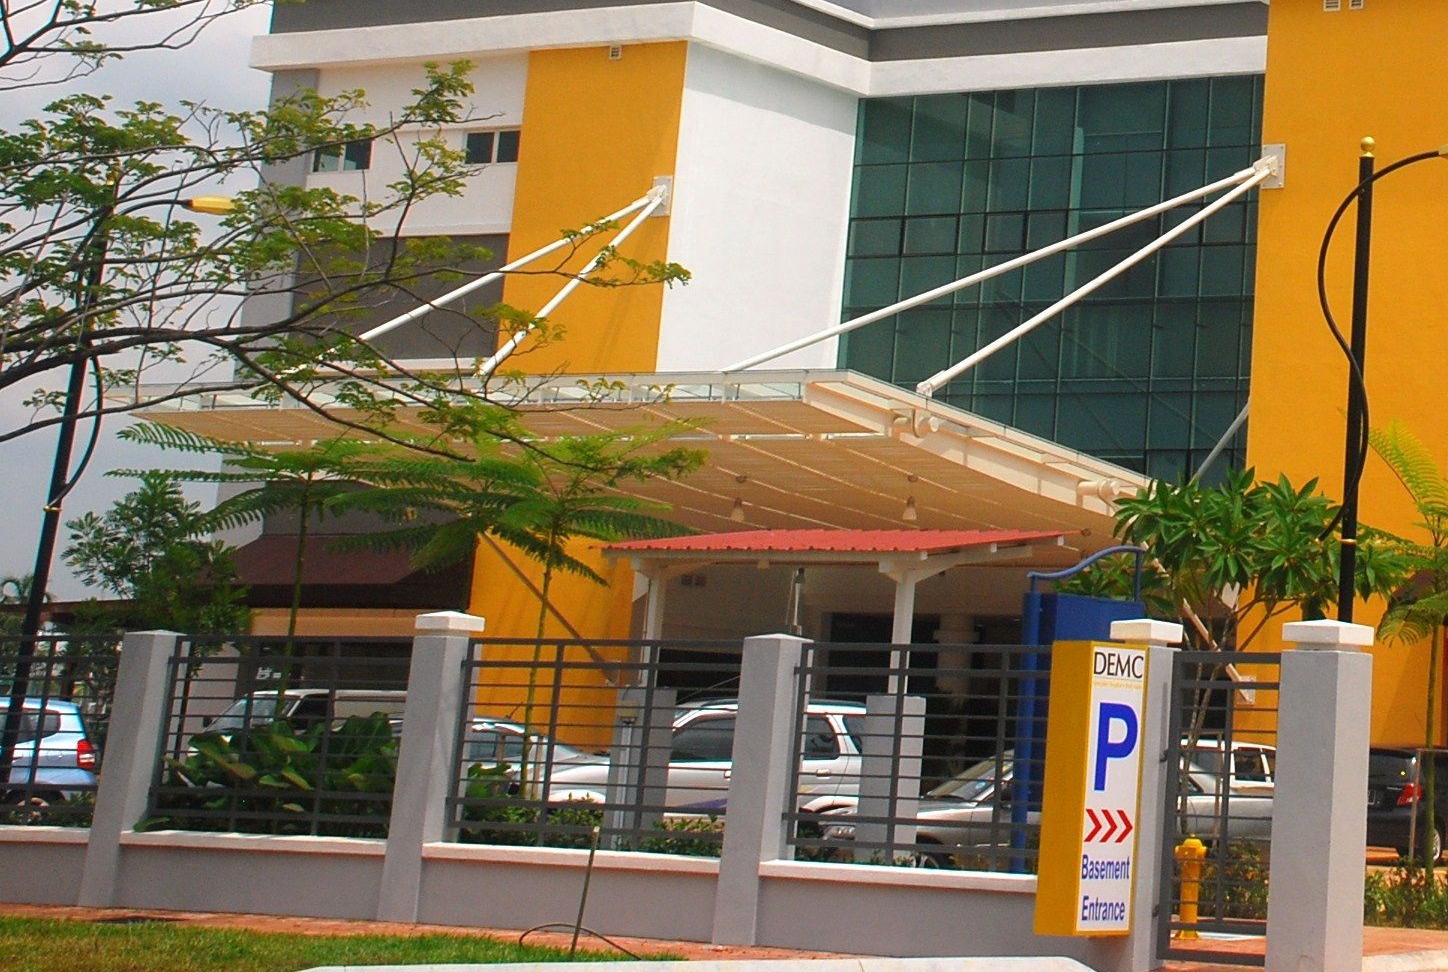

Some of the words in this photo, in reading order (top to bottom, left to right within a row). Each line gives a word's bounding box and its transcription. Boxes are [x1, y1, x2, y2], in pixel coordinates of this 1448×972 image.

[1093, 651, 1144, 679] DEMC
[1094, 702, 1138, 791] P
[1081, 855, 1130, 880] Basement
[1081, 896, 1126, 922] Entrance
